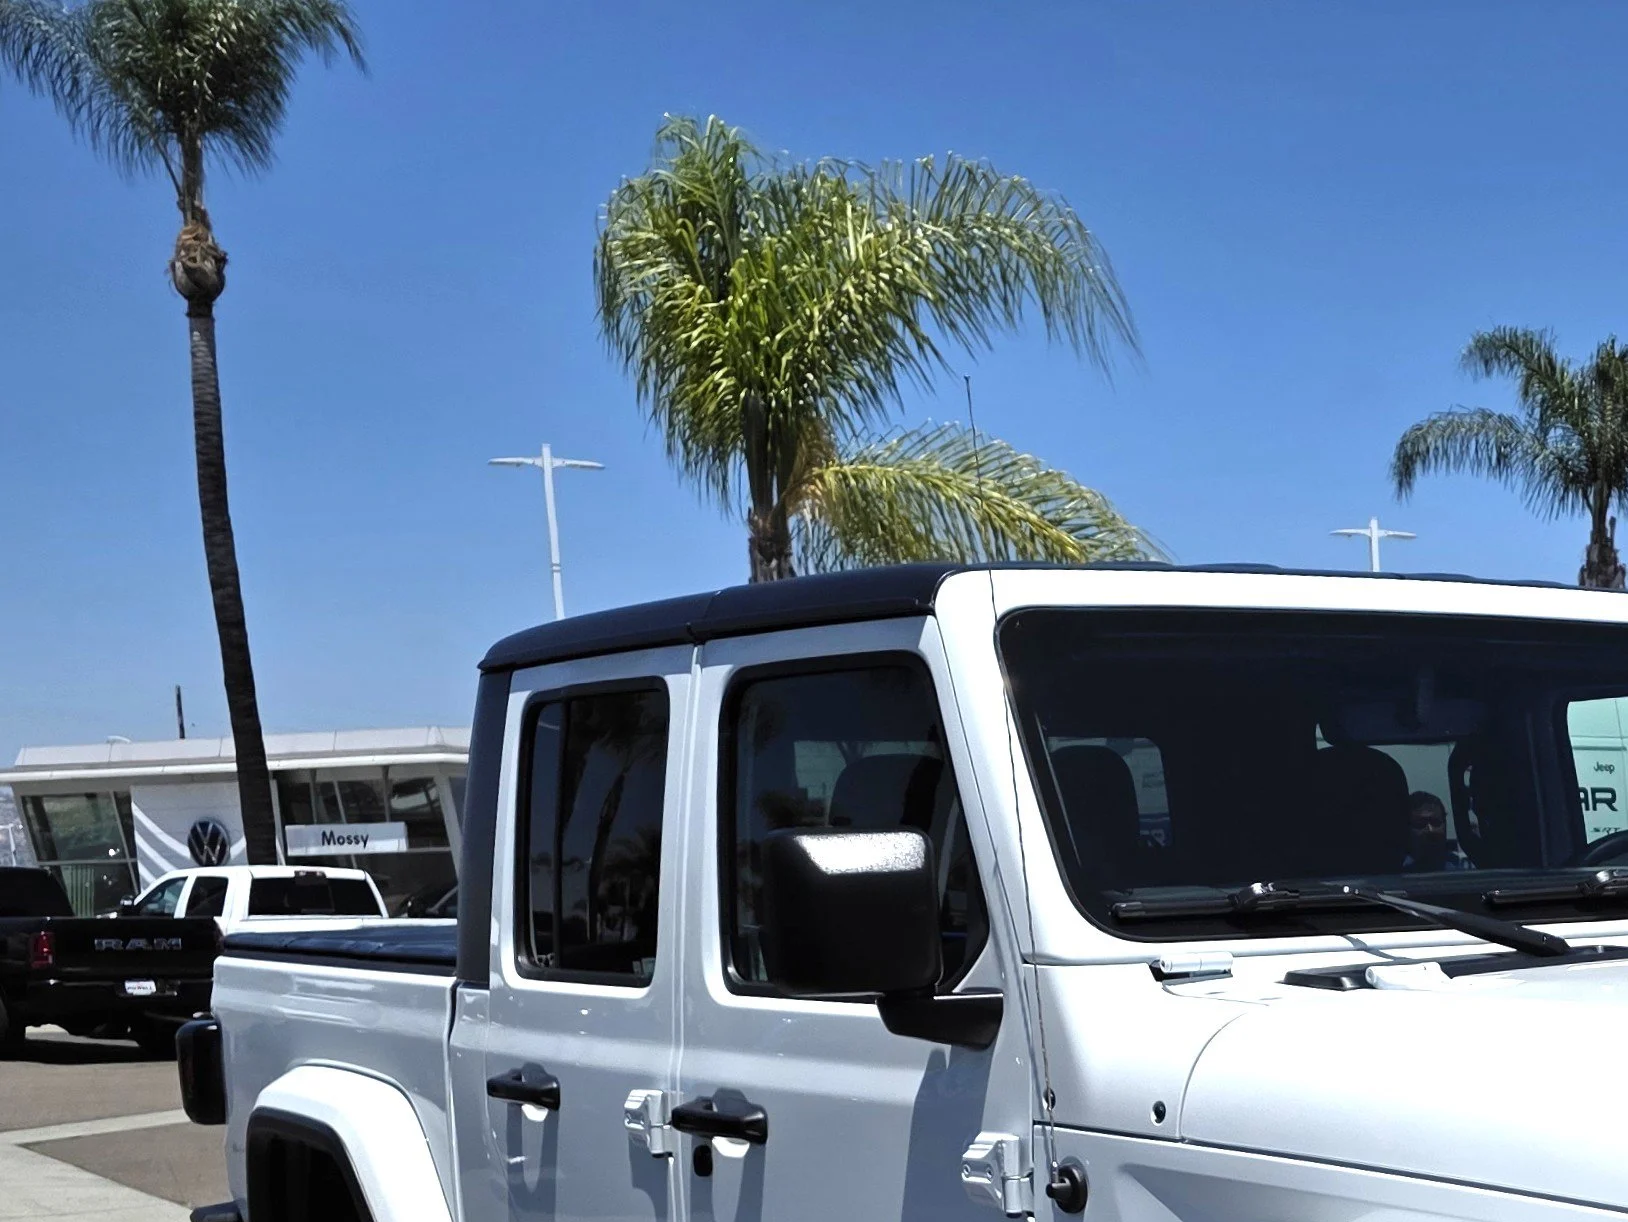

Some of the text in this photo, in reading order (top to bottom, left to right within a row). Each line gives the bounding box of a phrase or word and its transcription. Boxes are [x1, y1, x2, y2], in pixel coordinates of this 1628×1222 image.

[1593, 761, 1615, 774] Jeep
[321, 830, 370, 849] Mossy
[94, 937, 182, 951] RAM
